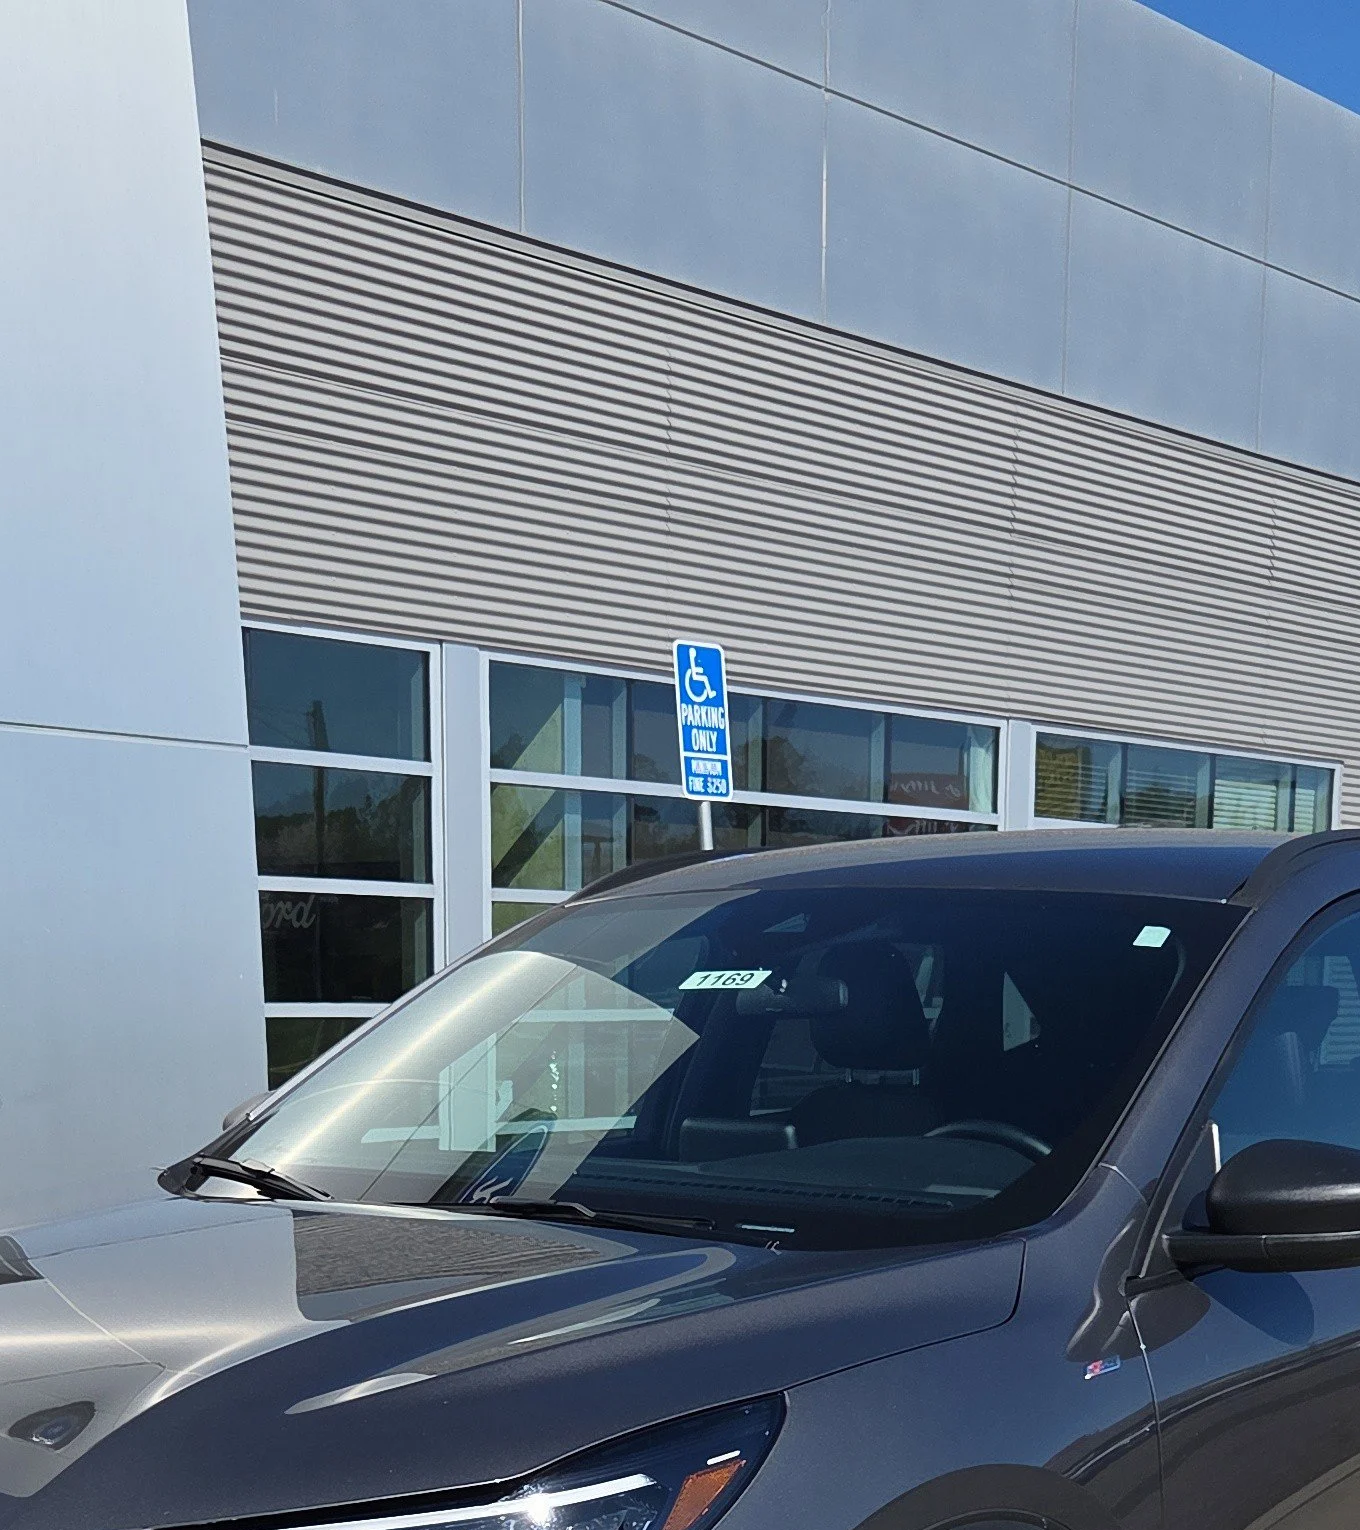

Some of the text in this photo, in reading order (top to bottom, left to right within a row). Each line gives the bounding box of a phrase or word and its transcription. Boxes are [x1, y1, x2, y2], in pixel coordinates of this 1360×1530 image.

[681, 703, 725, 730] PARKING
[691, 729, 718, 753] ONLY
[696, 972, 755, 987] 1169
